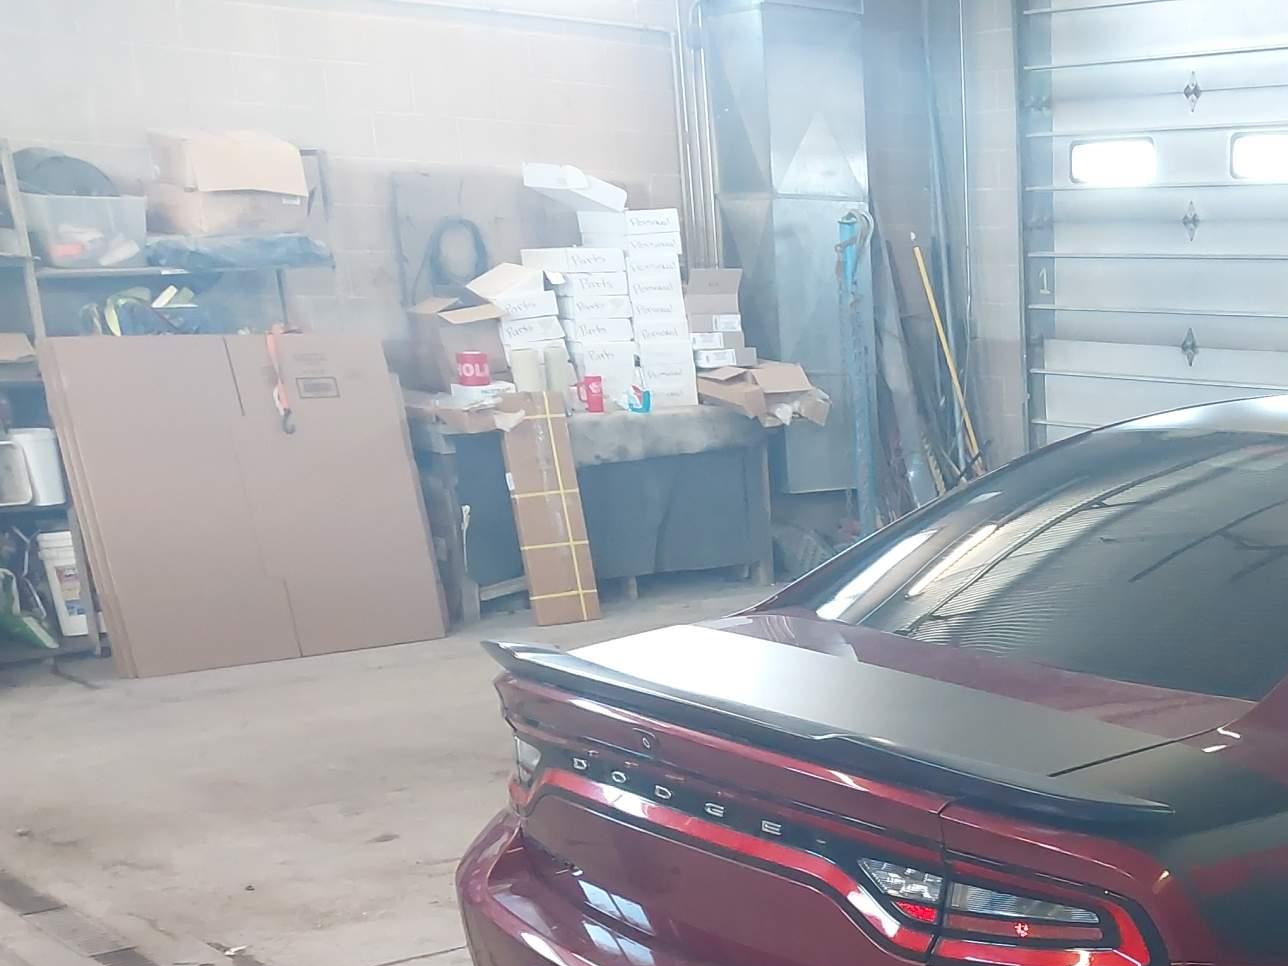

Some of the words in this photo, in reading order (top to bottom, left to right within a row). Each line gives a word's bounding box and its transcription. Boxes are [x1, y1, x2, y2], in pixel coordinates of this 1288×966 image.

[571, 253, 607, 266] Parts
[1039, 267, 1050, 294] 1
[573, 757, 782, 836] DODGE
